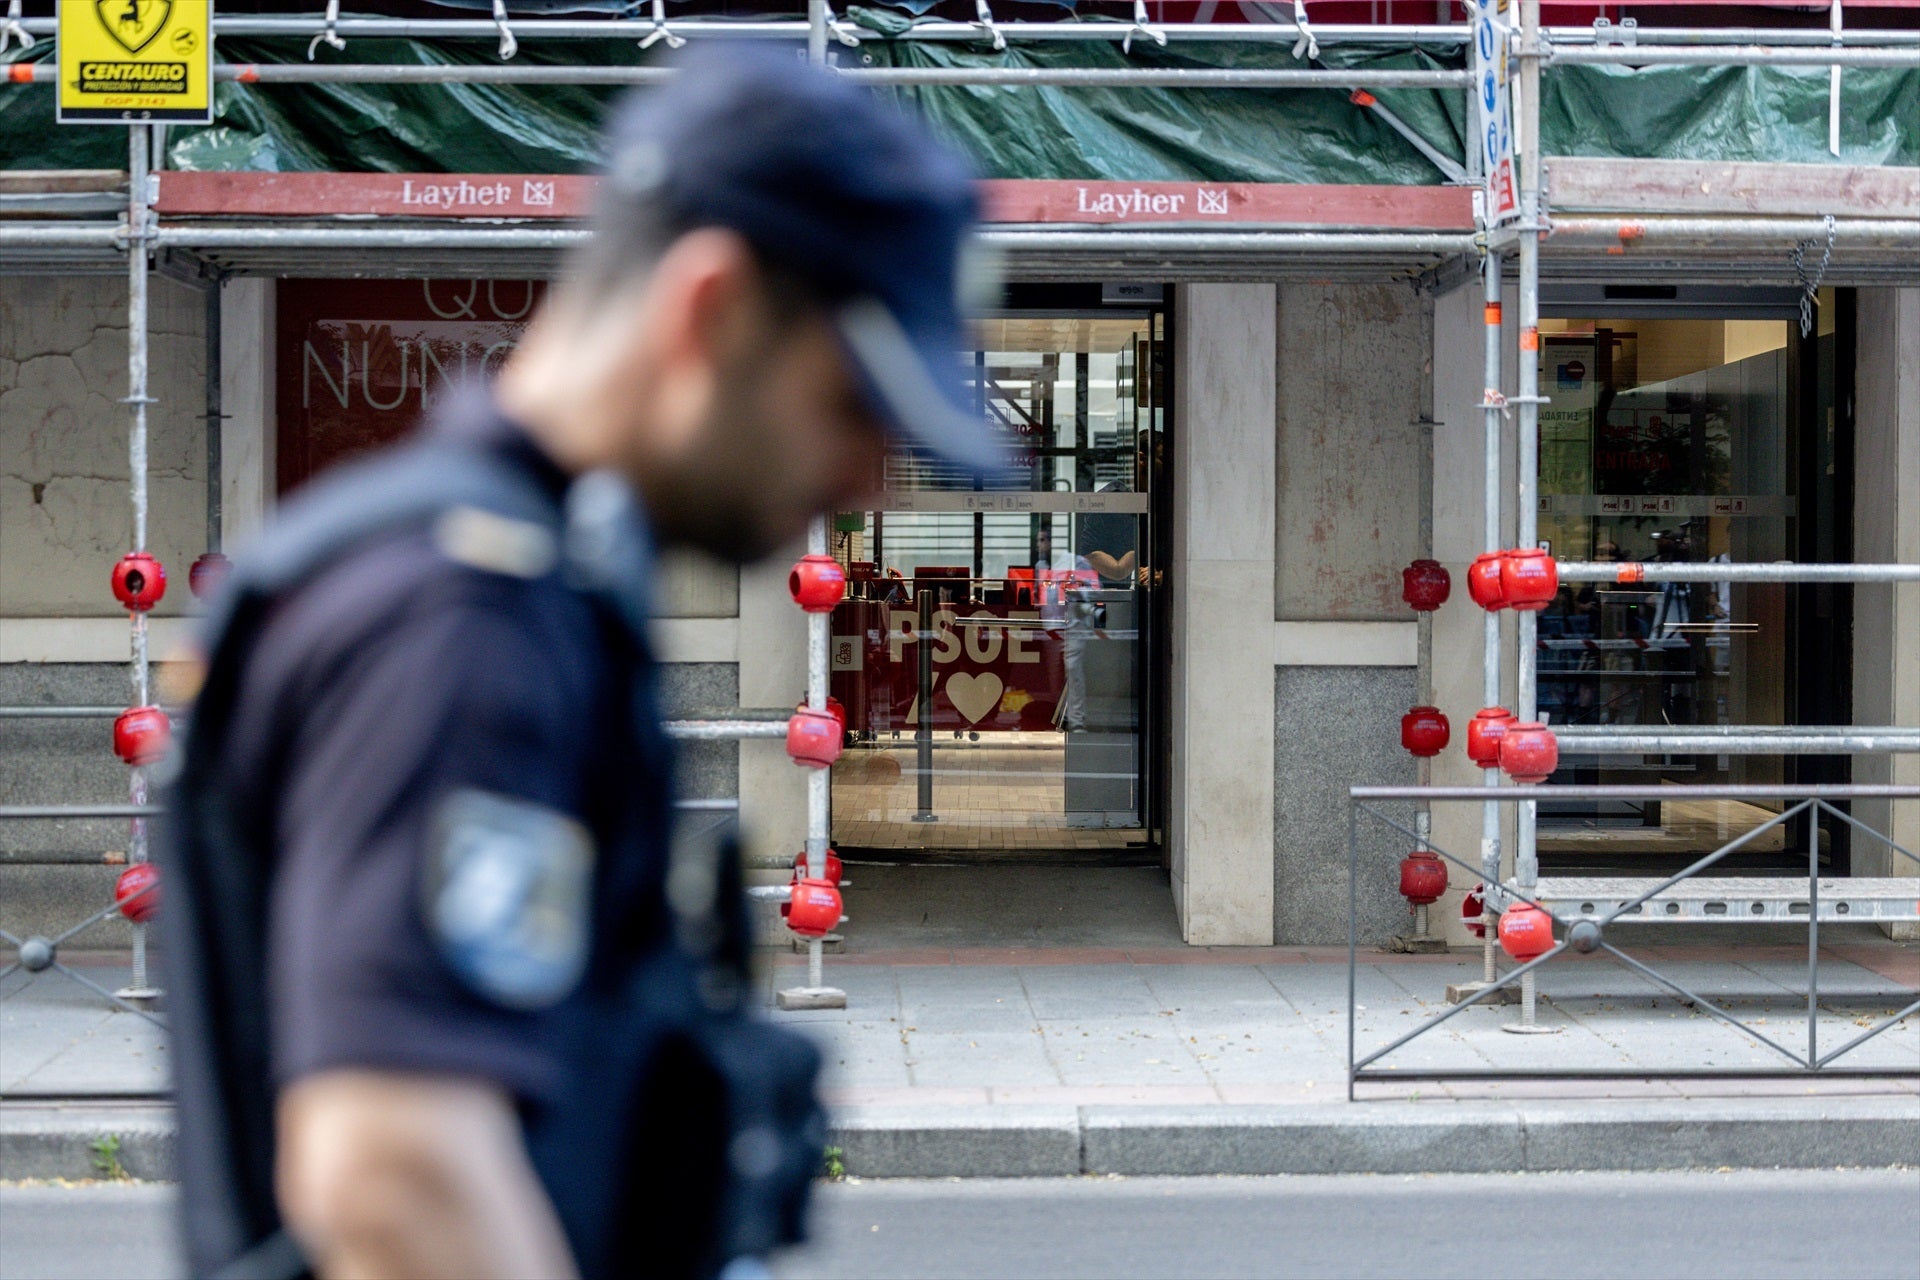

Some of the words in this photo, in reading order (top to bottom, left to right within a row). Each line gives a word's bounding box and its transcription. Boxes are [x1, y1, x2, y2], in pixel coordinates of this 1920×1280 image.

[82, 63, 186, 81] CENTAURO
[402, 179, 511, 210] Layher
[1077, 187, 1185, 218] Layher
[424, 278, 552, 320] QU
[889, 610, 1041, 664] PSOE
